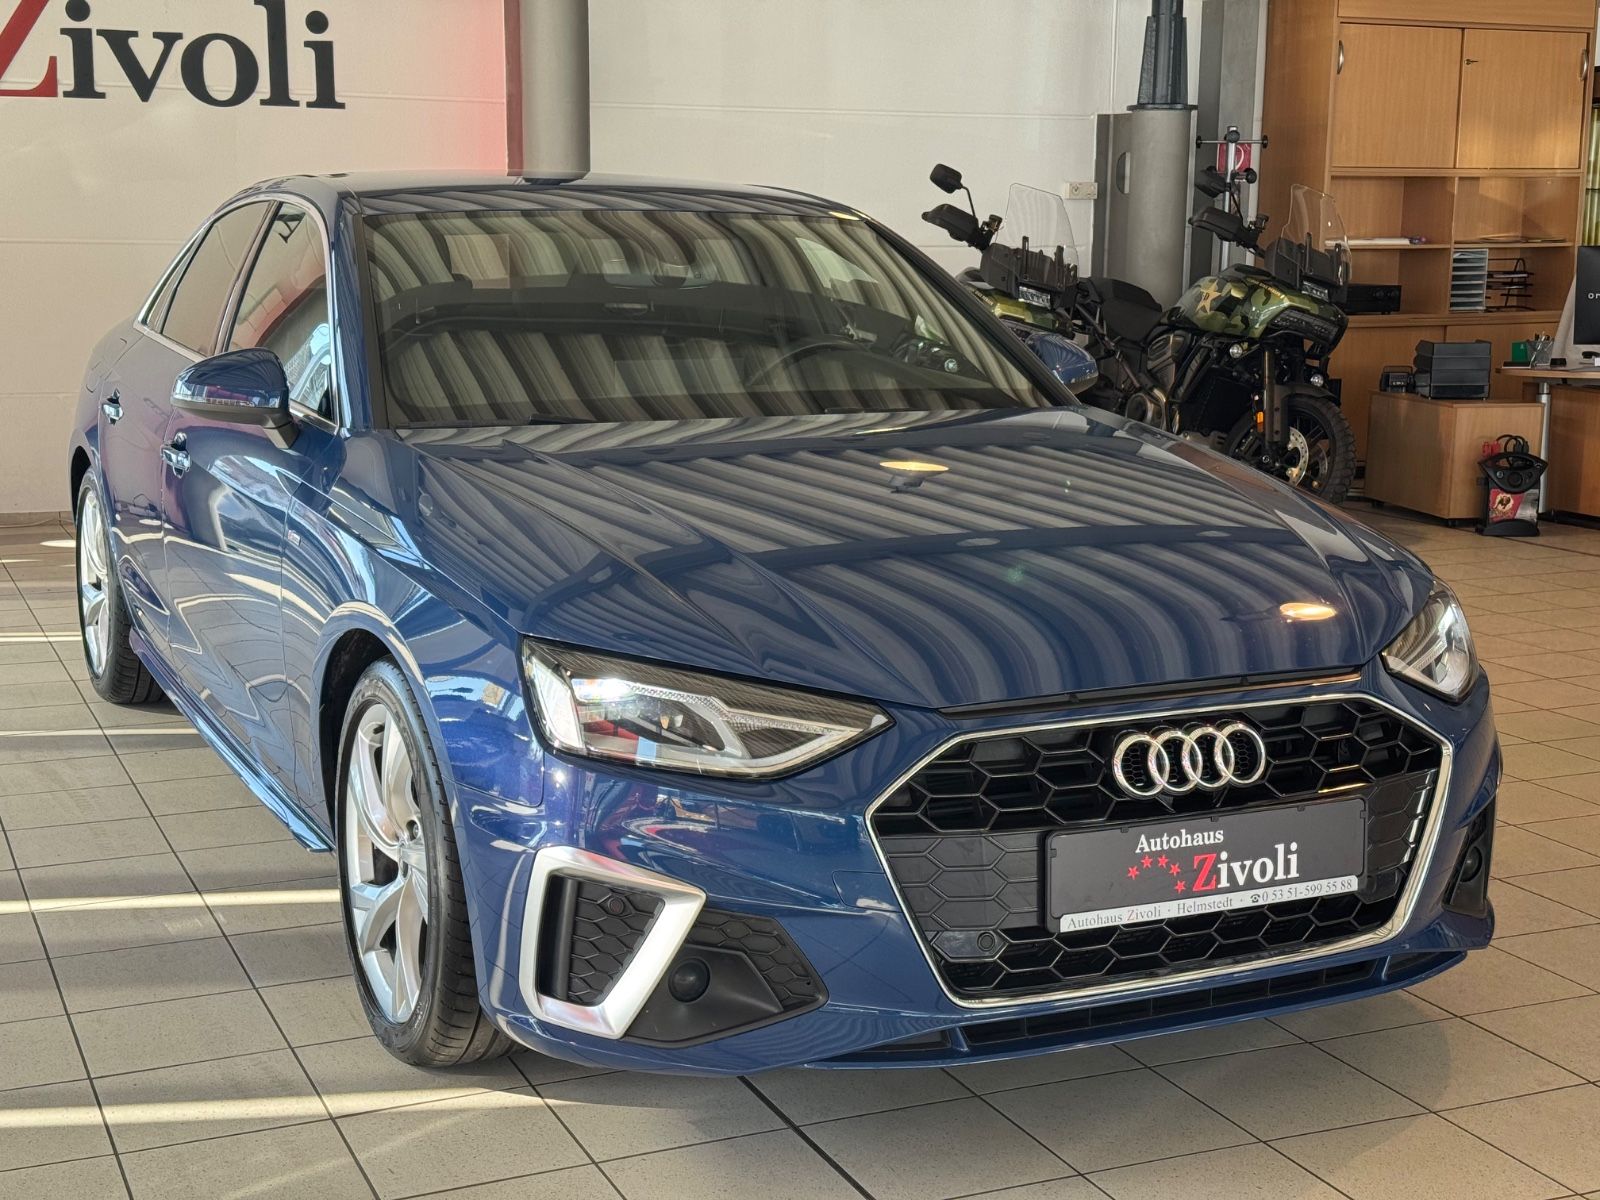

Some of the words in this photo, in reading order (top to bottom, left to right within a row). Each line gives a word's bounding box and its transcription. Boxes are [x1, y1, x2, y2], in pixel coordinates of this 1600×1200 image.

[1135, 829, 1224, 853] Autohaus
[1192, 842, 1299, 892] Zivoli
[1067, 912, 1123, 929] Autohaus
[1126, 906, 1161, 922] Zivoli
[1177, 896, 1233, 914] Helmstedt
[1340, 878, 1353, 891] 88
